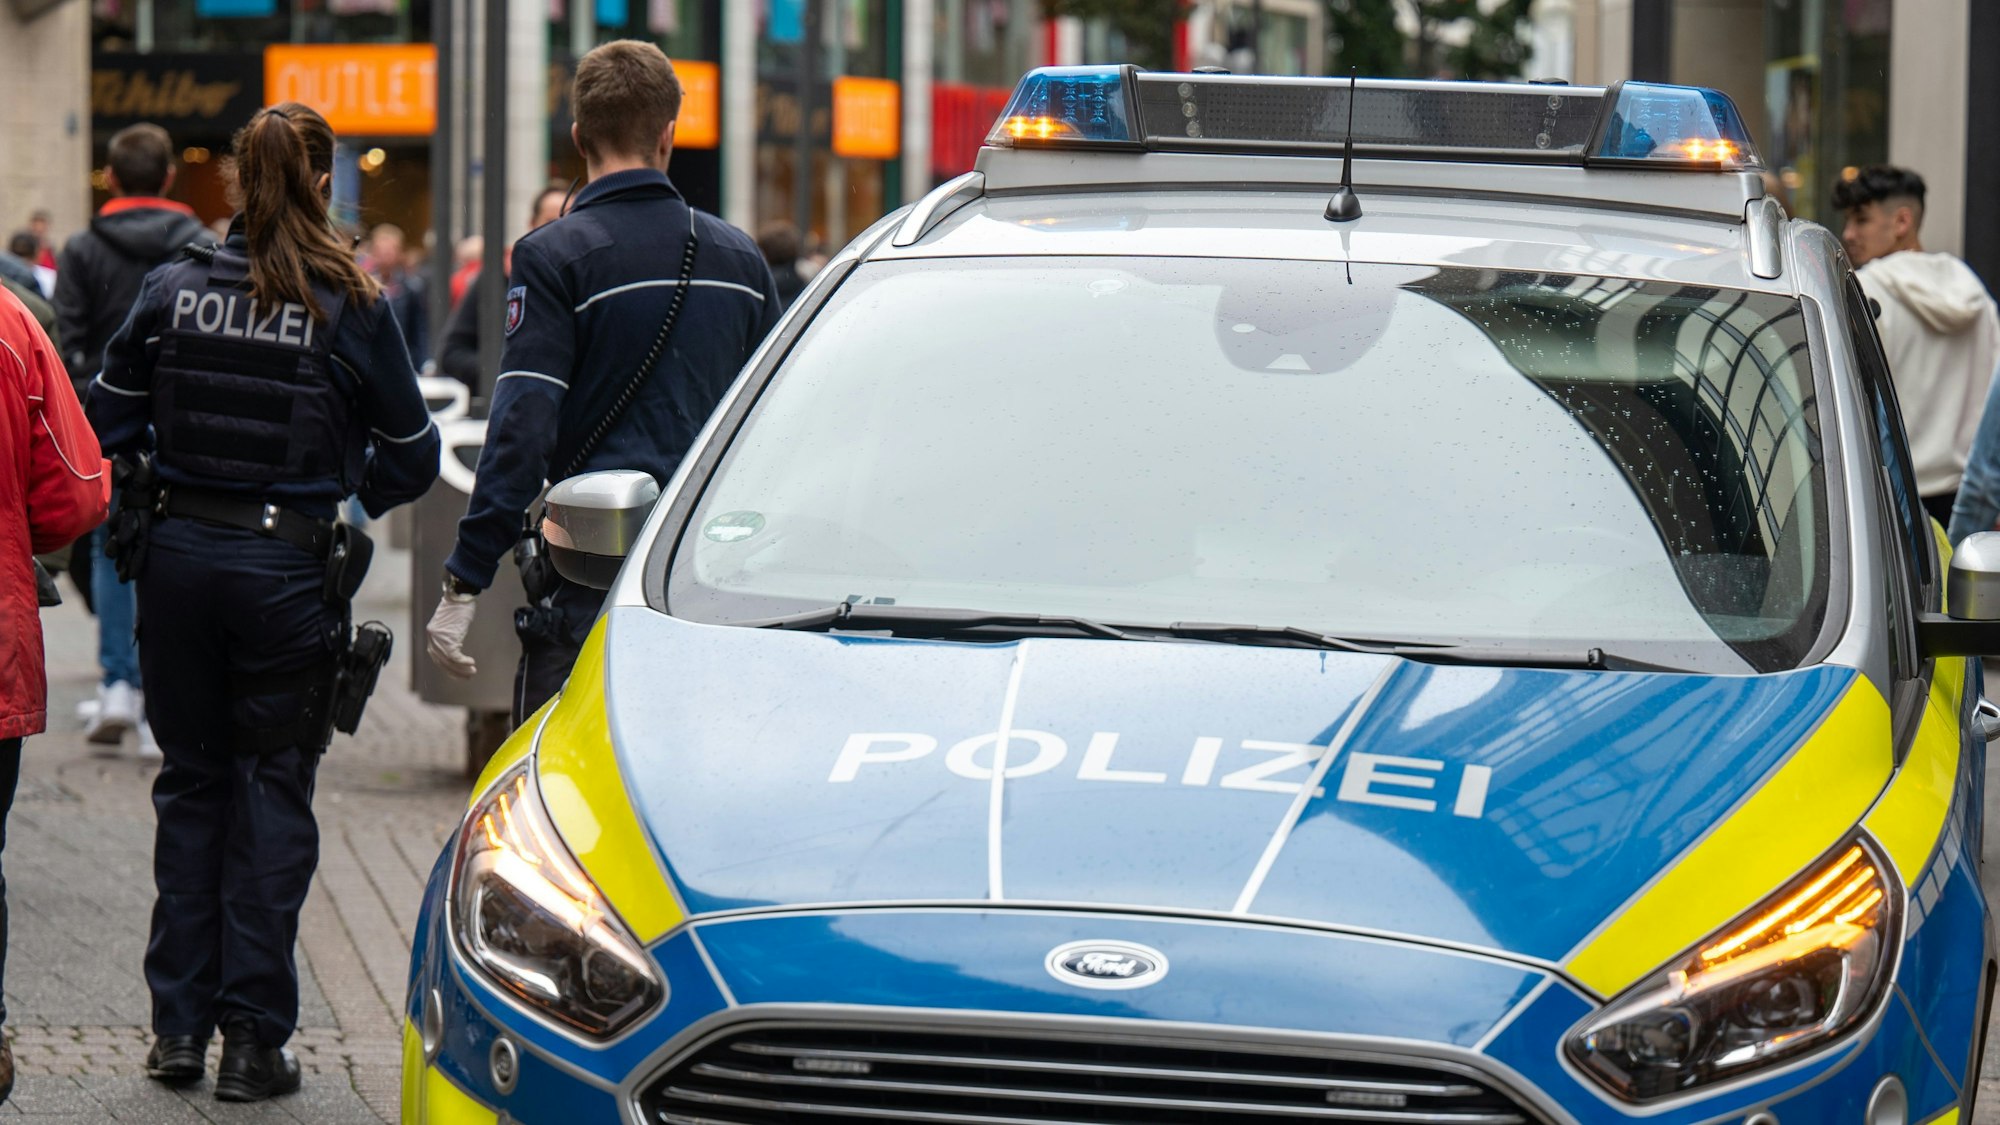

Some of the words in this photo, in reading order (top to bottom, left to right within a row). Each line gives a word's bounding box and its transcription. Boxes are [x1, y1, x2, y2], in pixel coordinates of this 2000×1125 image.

[275, 60, 436, 117] OUTLET
[172, 289, 315, 347] POLIZEI
[826, 729, 1493, 819] POLIZEI
[1076, 952, 1137, 977] Ford
